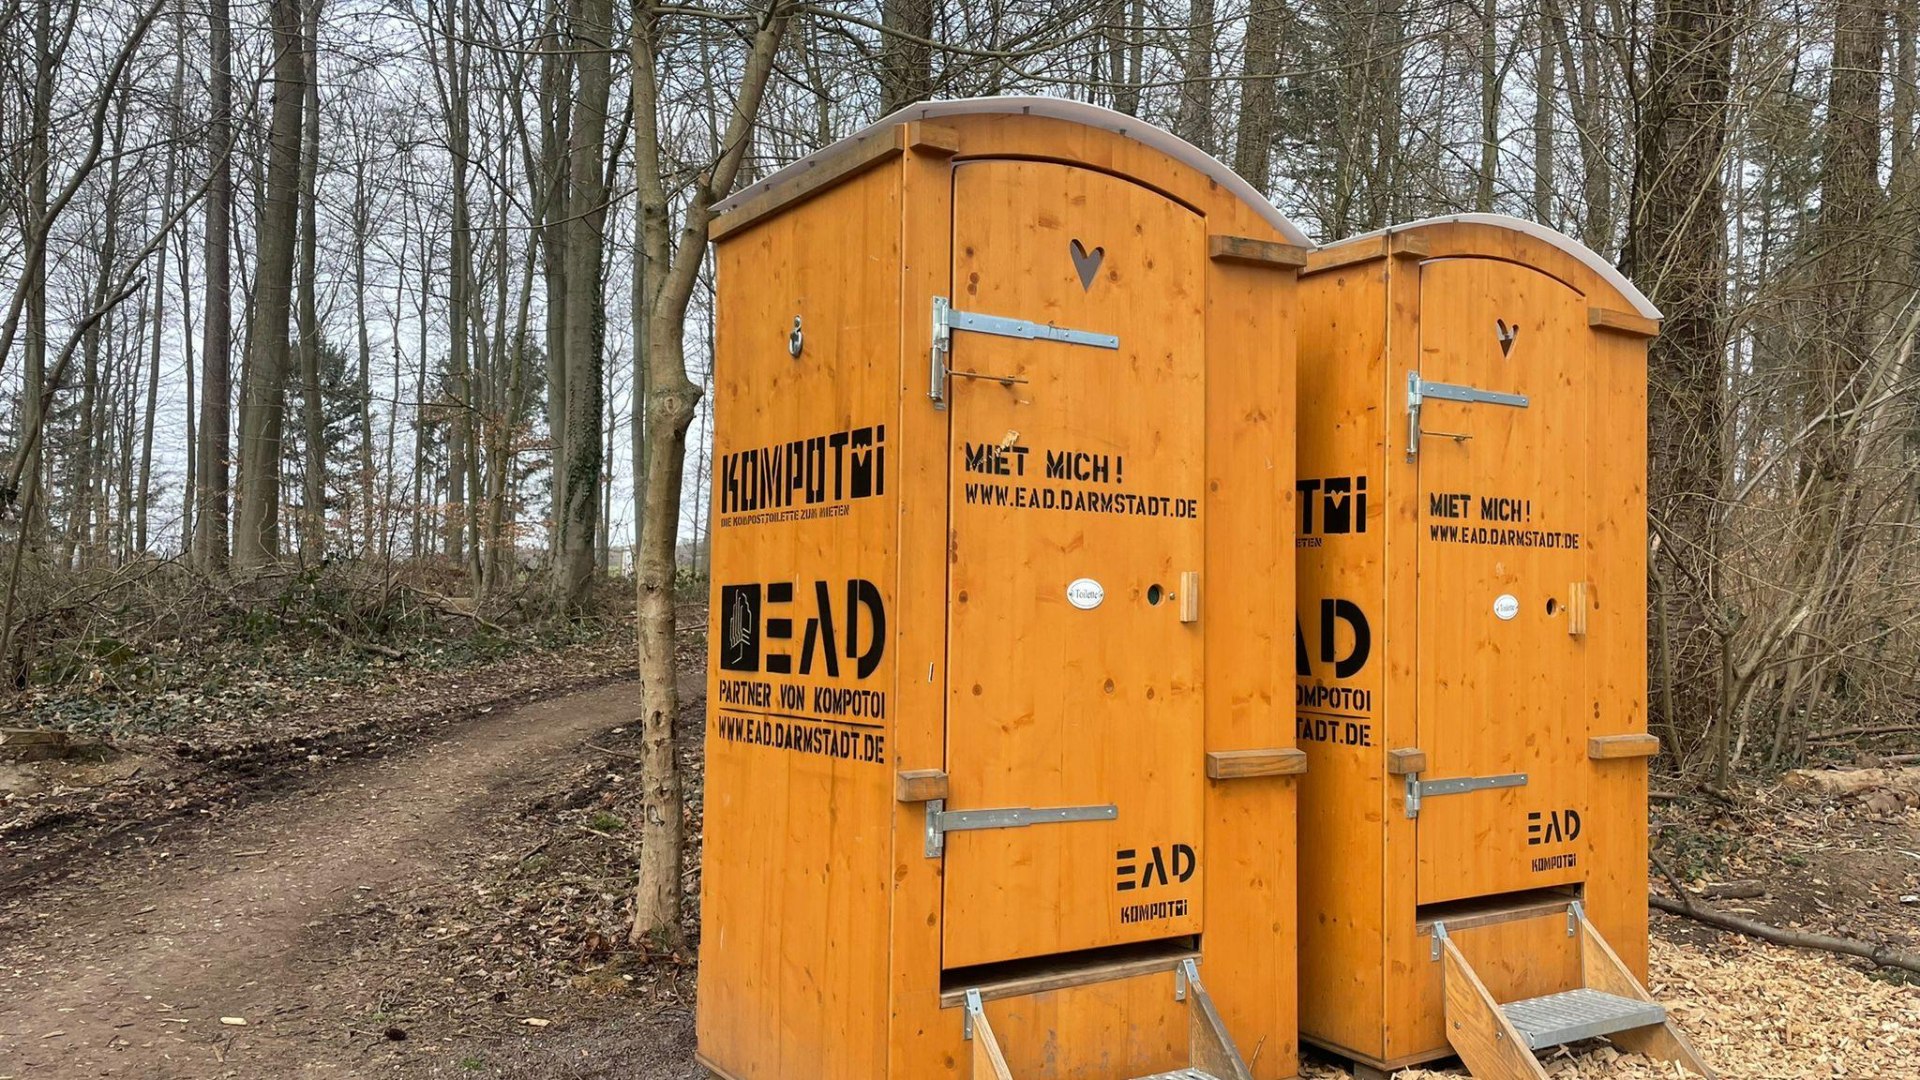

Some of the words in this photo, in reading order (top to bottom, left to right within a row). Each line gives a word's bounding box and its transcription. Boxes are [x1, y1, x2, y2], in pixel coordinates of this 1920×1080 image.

[965, 442, 1029, 476] MIET
[721, 516, 732, 527] DIE
[800, 508, 818, 520] ZUM
[819, 504, 850, 518] MIETEN
[965, 483, 1197, 518] WWW.EAD.DARMSTADT.DE
[1430, 492, 1471, 519] MIET
[1296, 537, 1322, 547] ETEN
[1430, 525, 1579, 549] WWW.EAD.DARMSTADT.DE
[766, 579, 886, 679] EAD
[719, 680, 772, 708] PARTNER
[780, 683, 805, 711] VON
[813, 686, 885, 719] KOMPOTOI
[1296, 685, 1371, 712] OMPOTOI
[718, 716, 885, 765] WWW.EAD.DARMSTADT.DE
[1527, 809, 1581, 845] EAD
[1116, 844, 1196, 891] EAD
